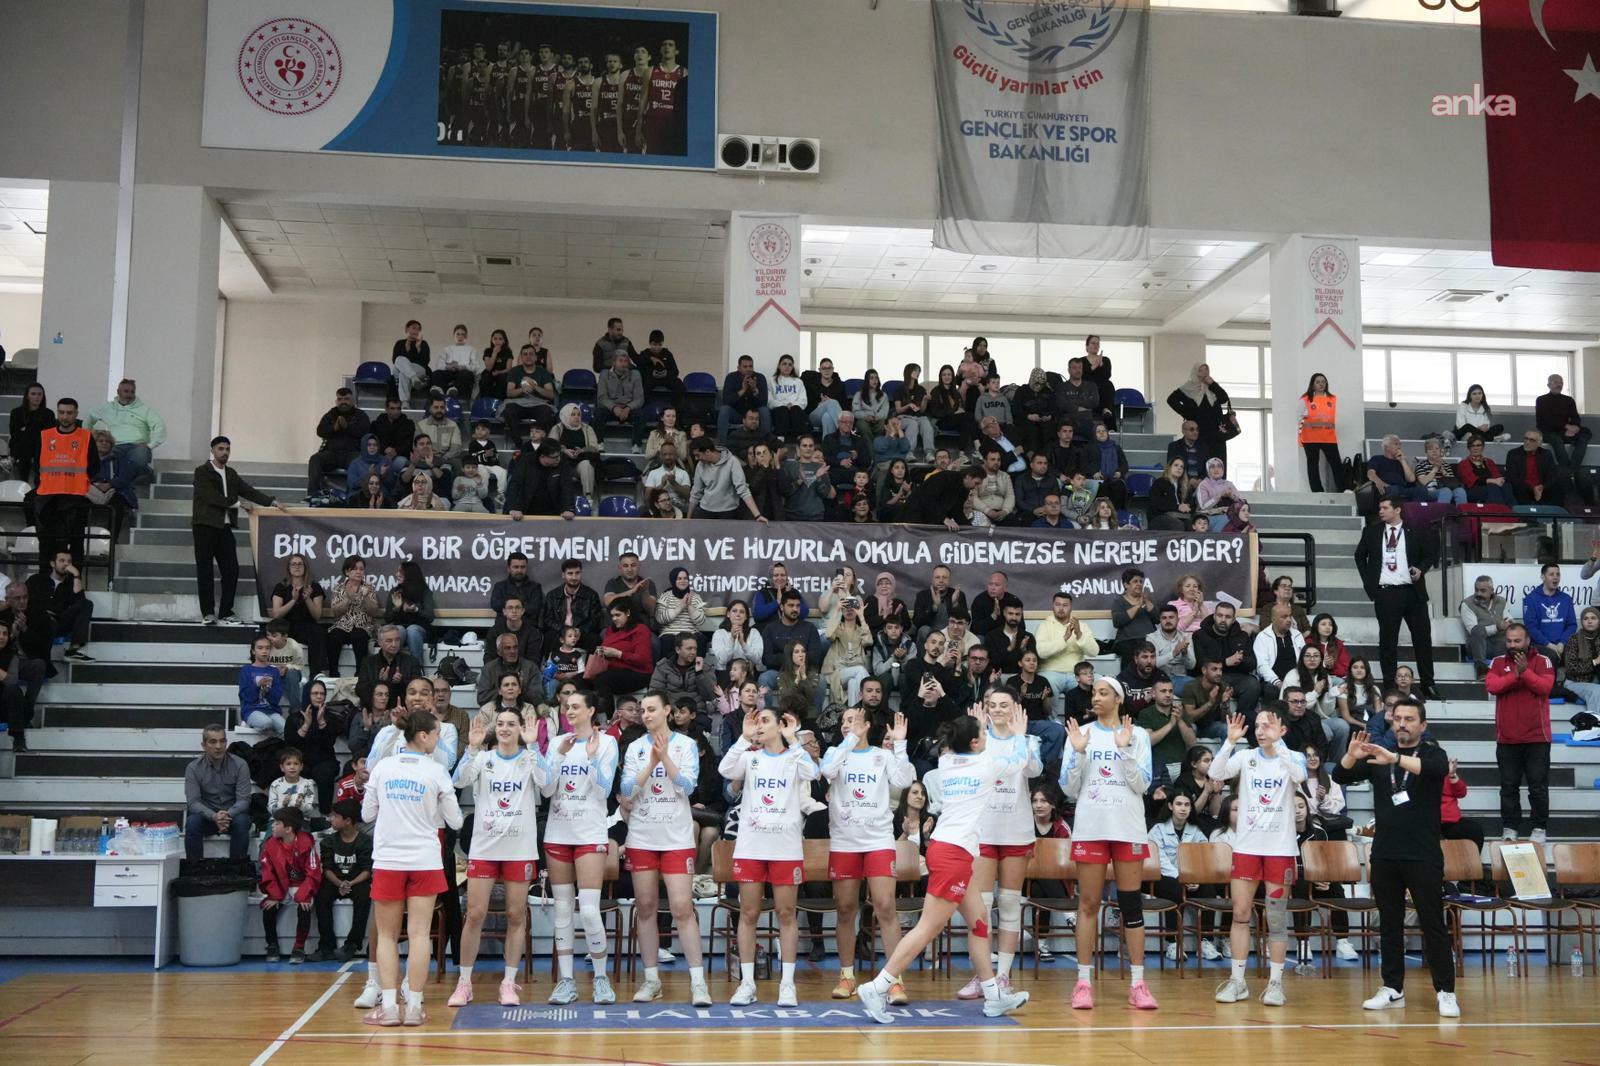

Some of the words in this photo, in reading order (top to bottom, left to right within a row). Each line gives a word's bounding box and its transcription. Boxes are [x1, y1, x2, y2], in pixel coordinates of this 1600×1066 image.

[952, 44, 999, 84] Güçlü
[999, 76, 1070, 96] yarınlar
[1071, 68, 1104, 91] için
[652, 79, 677, 89] TÜRKİY
[660, 89, 671, 100] 12
[960, 119, 1040, 140] GENÇLİK
[1042, 124, 1066, 141] VE
[1070, 125, 1118, 144] SPOR
[989, 142, 1090, 163] BAKANLIĞI
[984, 401, 1006, 409] USPA
[274, 533, 317, 559] BİR
[325, 534, 413, 563] ÇOCUK,
[422, 534, 462, 560] BİR
[471, 529, 610, 561] ÖĞRETMEN!
[618, 535, 696, 561] GÜVEN
[704, 536, 735, 561] VE
[743, 536, 847, 562] HUZURLA
[855, 539, 932, 564] OKULA
[939, 541, 1066, 565] GİDEMEZSE
[1074, 539, 1158, 565] NEREYE
[1166, 537, 1243, 564] GİDER?
[1060, 577, 1154, 598] #ŞANLIUA
[268, 655, 294, 664] ARLESS
[384, 779, 426, 795] TURGUTLU
[593, 1008, 962, 1019] HALKBANK
